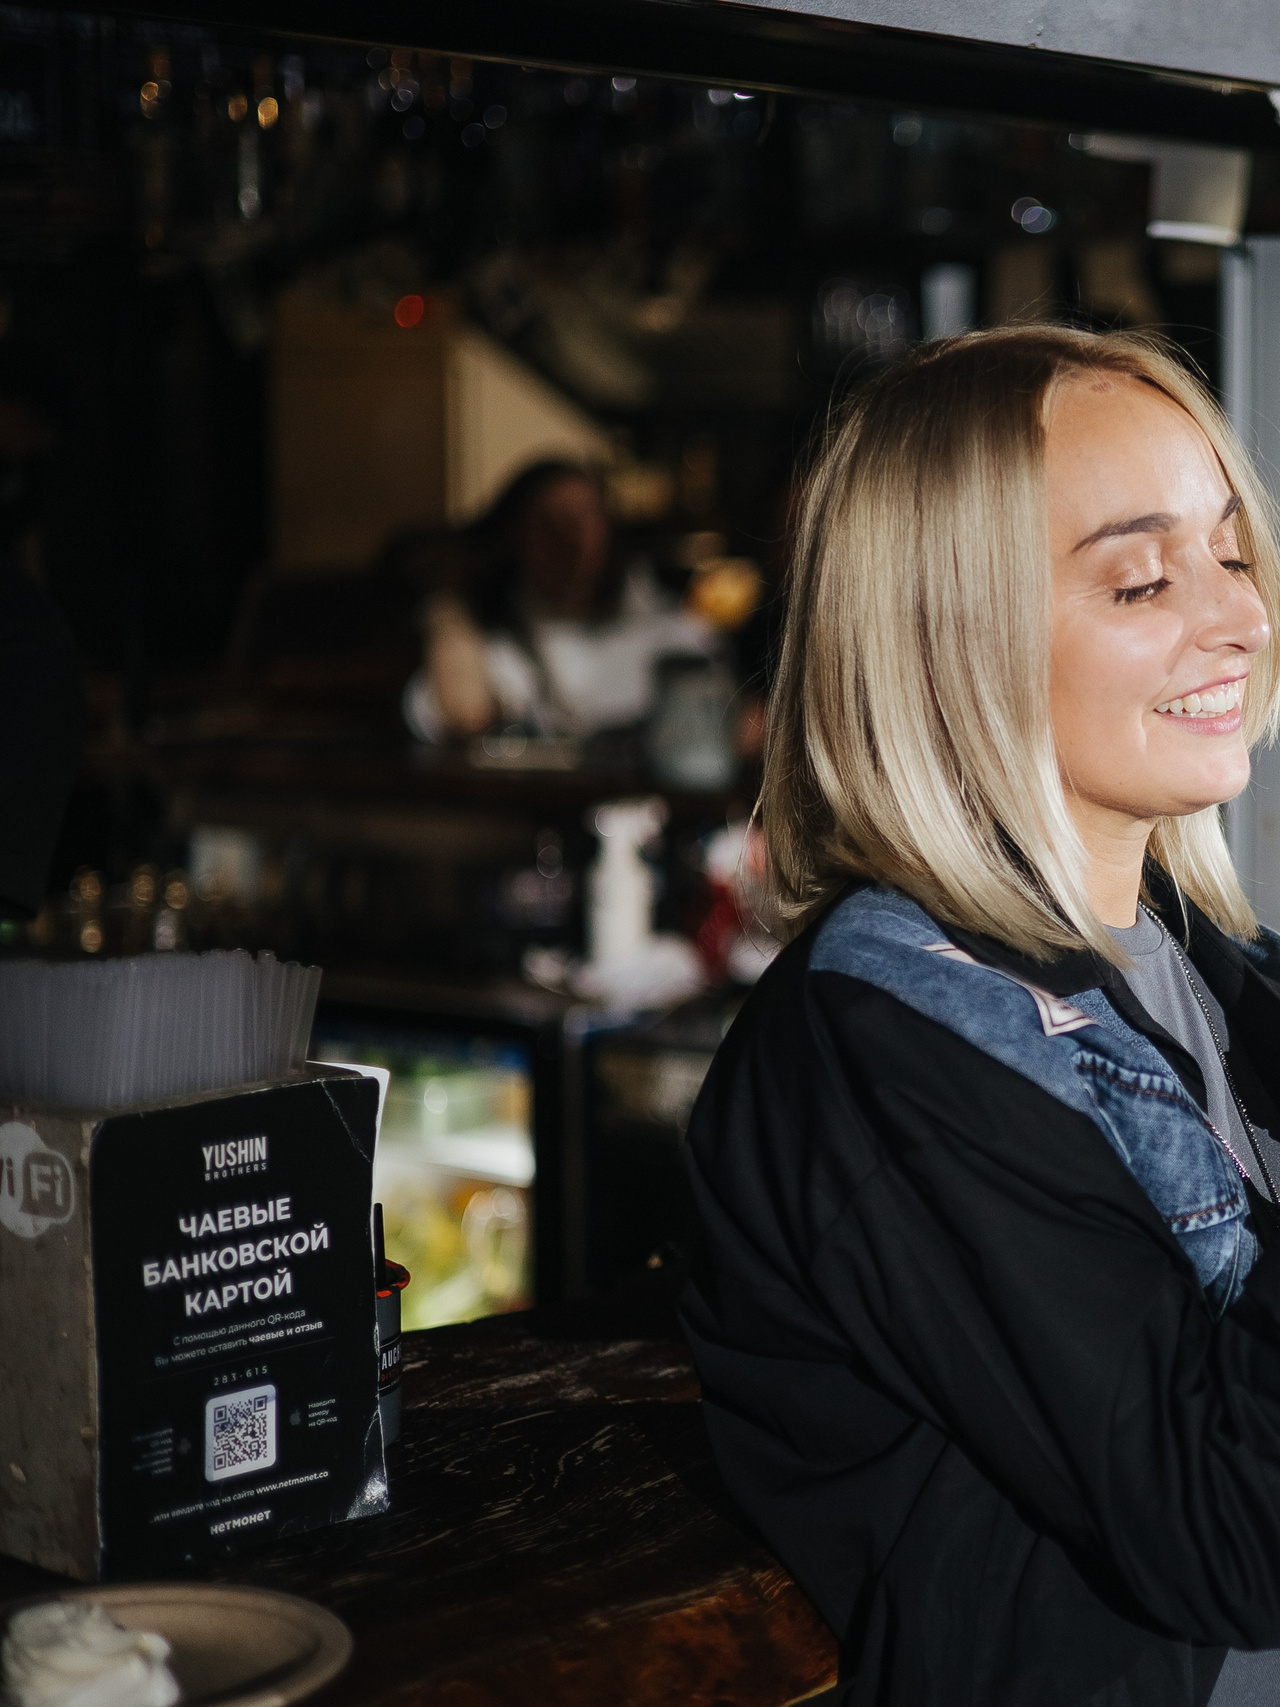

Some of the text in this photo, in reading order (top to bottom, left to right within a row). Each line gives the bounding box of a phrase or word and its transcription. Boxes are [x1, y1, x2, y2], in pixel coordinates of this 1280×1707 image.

[202, 1136, 267, 1171] YUSHIN
[204, 1162, 267, 1181] BROTHERS
[178, 1197, 292, 1239] ЧАЕВЫЕ
[143, 1222, 329, 1287] БАНКОВСКОЙ
[185, 1267, 293, 1317] КАРТОЙ
[171, 1348, 206, 1363] можете
[207, 1338, 248, 1354] оставить
[249, 1330, 285, 1344] чаевые
[294, 1321, 323, 1334] отзыв
[181, 1327, 227, 1344] помощью
[227, 1318, 266, 1335] данного
[267, 1309, 306, 1326] QR-кода
[256, 1470, 329, 1495] www.netmonet.co
[210, 1509, 272, 1535] нетмонет
